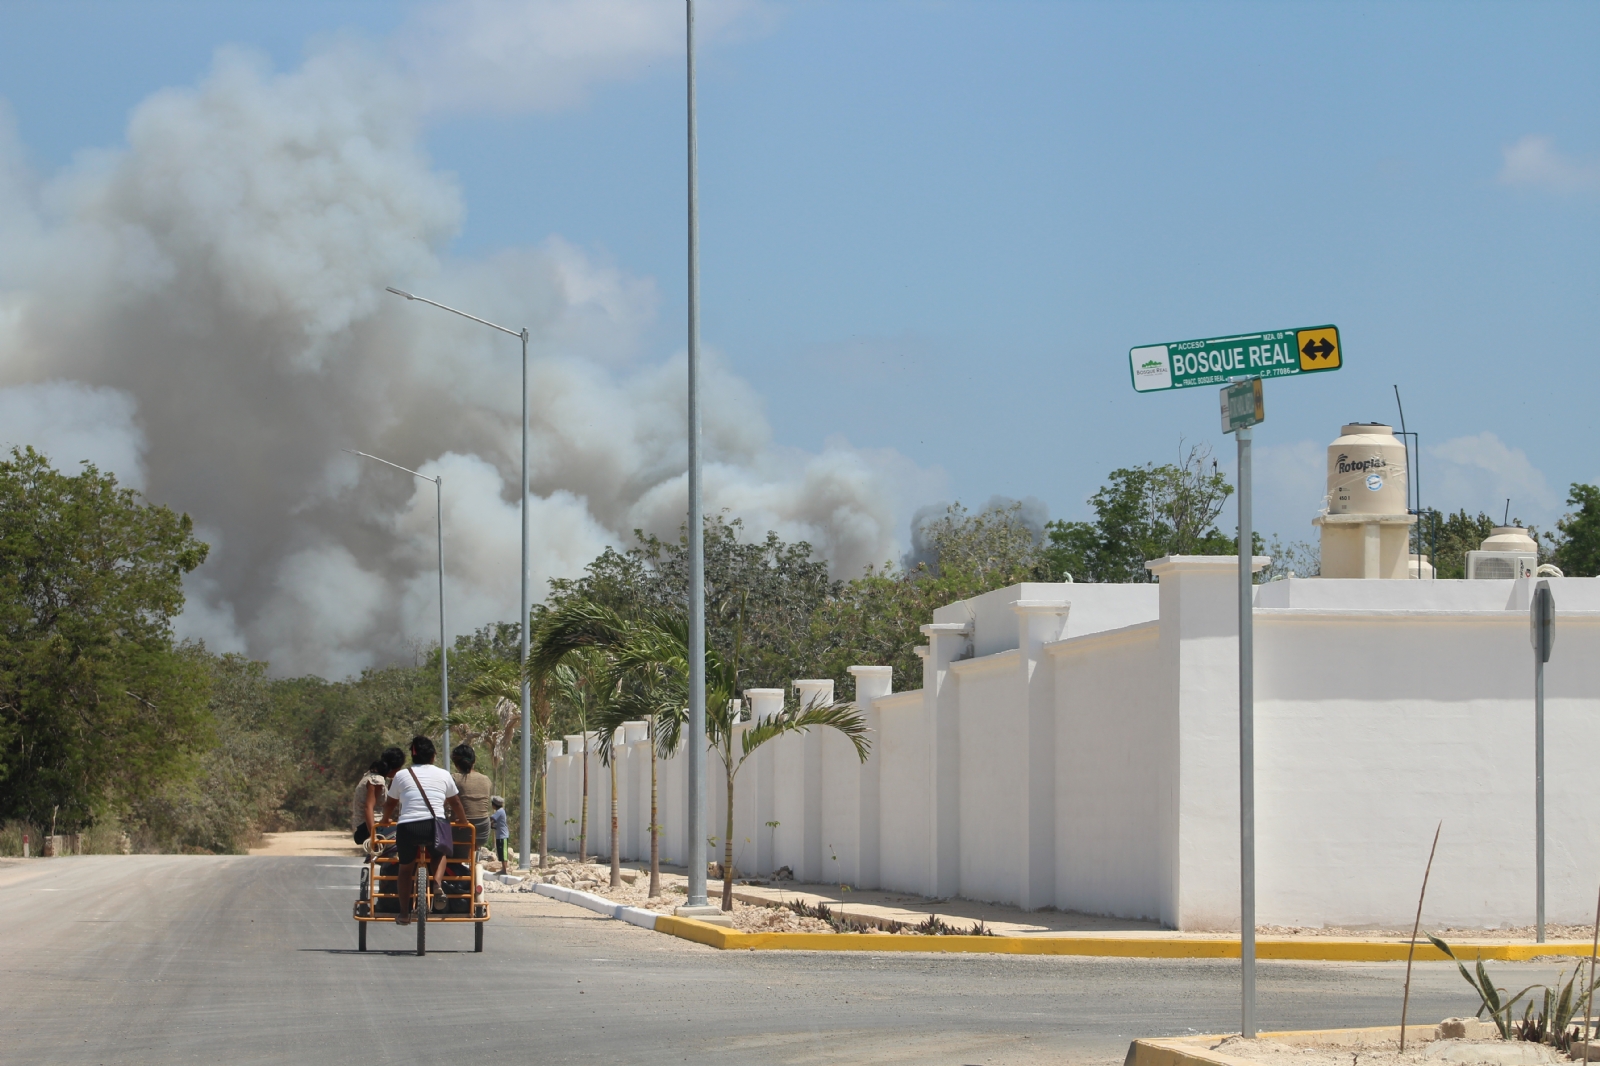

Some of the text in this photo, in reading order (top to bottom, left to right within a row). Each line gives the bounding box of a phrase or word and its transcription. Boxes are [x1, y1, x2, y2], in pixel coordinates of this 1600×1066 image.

[1263, 333, 1276, 341] MZA.
[1178, 341, 1205, 350] ACCESO
[1173, 343, 1295, 375] BOSQUE REAL
[1183, 375, 1225, 386] FRACC. BOSQUE REAL
